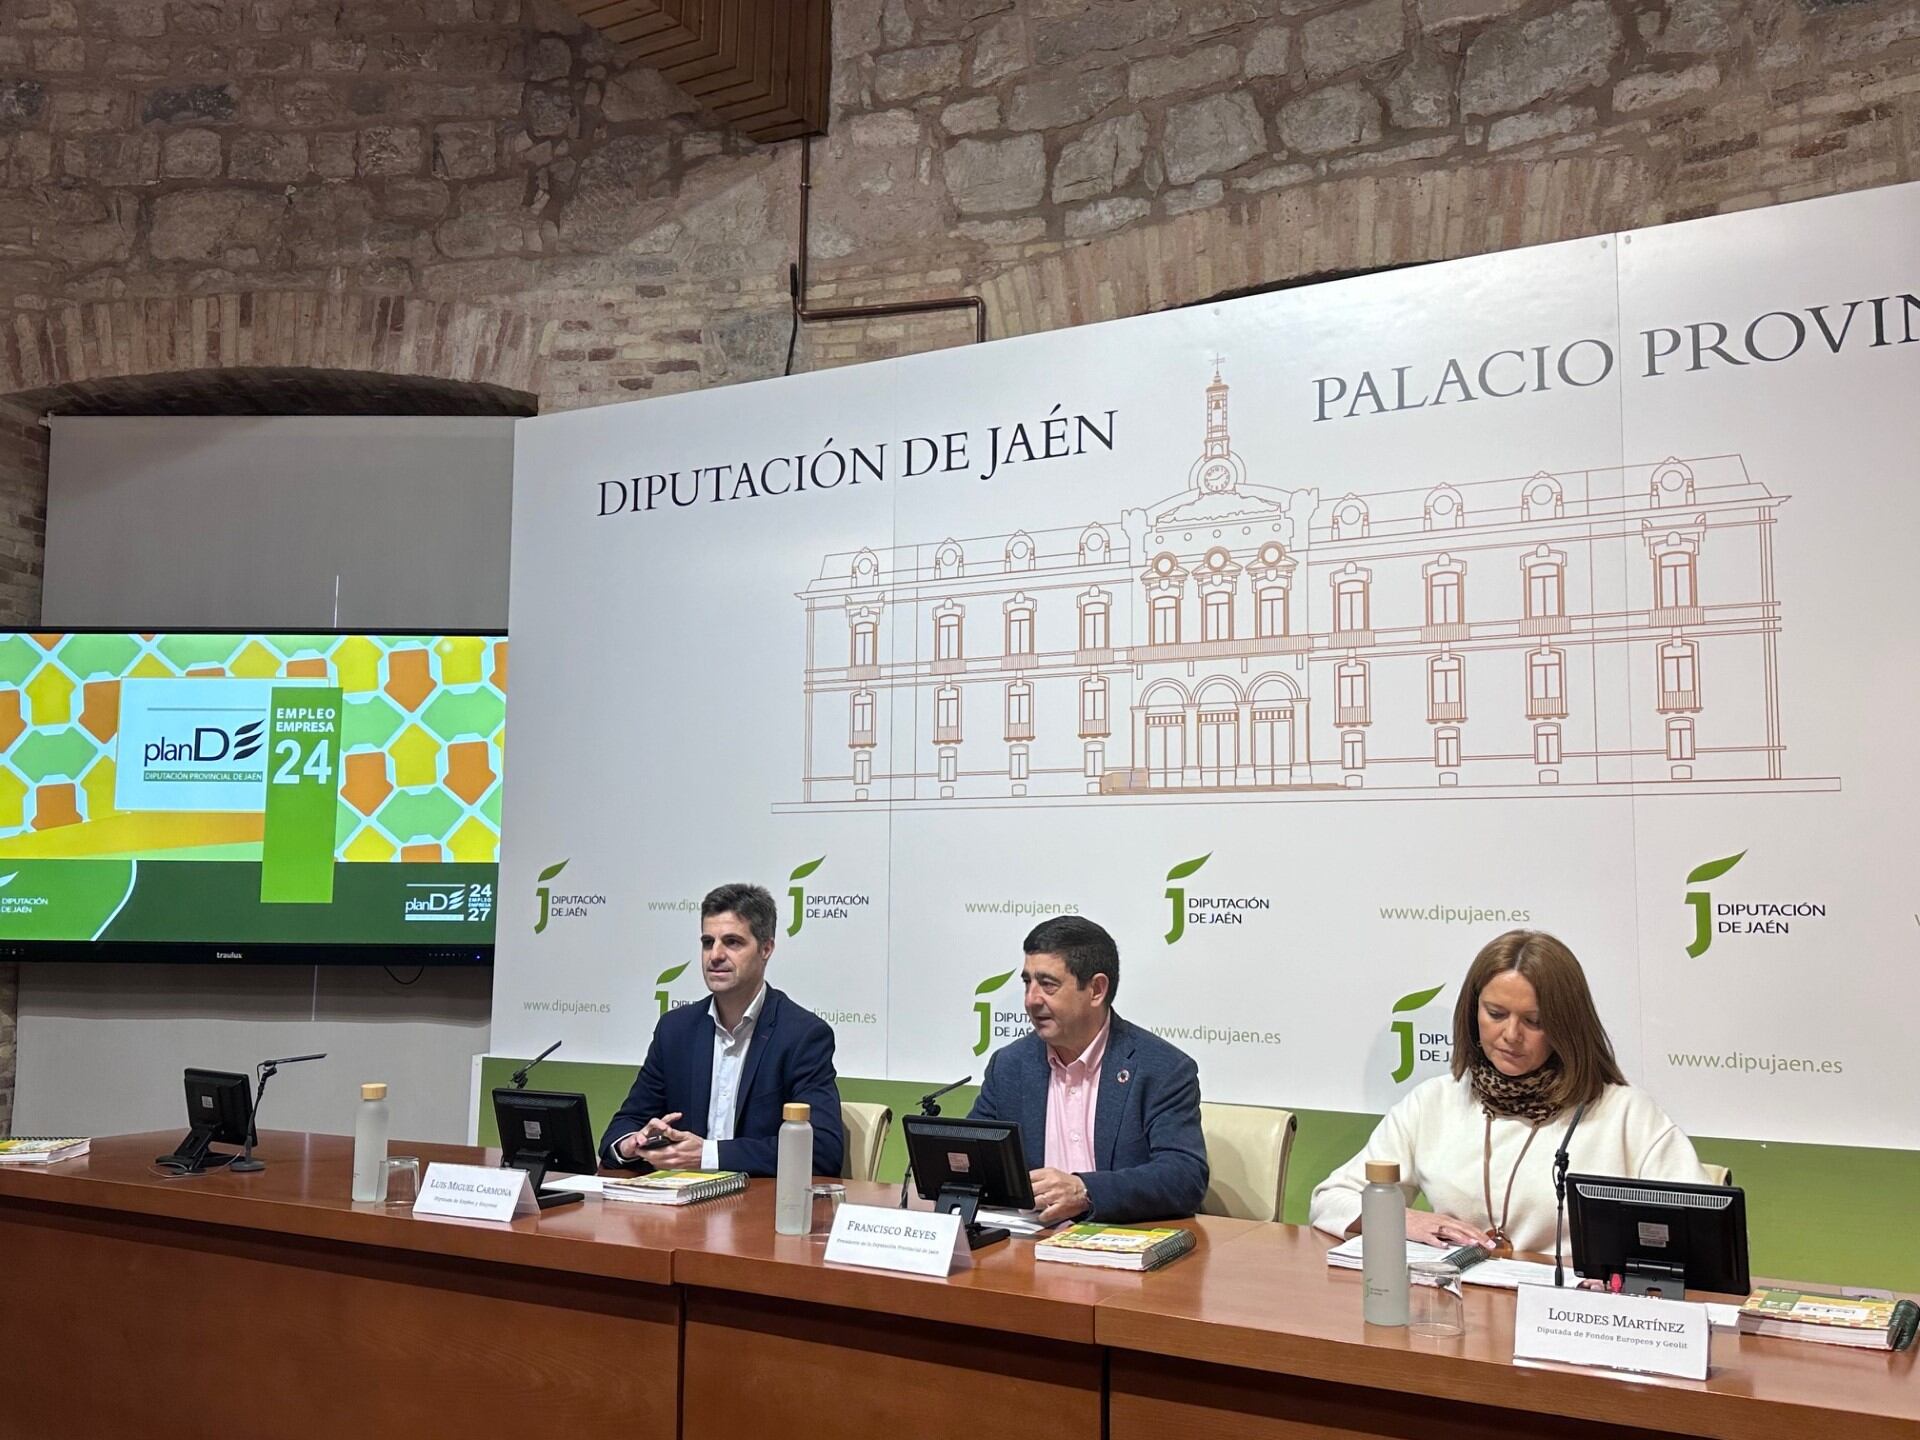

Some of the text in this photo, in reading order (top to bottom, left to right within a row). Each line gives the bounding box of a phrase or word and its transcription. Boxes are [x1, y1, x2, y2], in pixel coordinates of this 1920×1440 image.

[1312, 339, 1615, 422] PALACIO
[597, 404, 1118, 516] DIPUTACIÓN DE JAÉN
[276, 707, 335, 719] EMPLEO
[275, 721, 334, 733] EMPRESA
[272, 739, 332, 784] 24
[145, 772, 188, 780] DIPUTACIÓN
[189, 772, 231, 780] PROVINCIAL
[469, 883, 492, 897] 24
[1, 897, 48, 905] DIPUTACIÓN
[551, 894, 606, 904] DIPUTACIÓN
[806, 893, 869, 905] DIPUTACIÓN
[1188, 897, 1269, 909] DIPUTACIÓN
[467, 908, 491, 921] 27
[551, 906, 587, 916] DE JAÉN
[806, 907, 848, 918] DE JAÉN
[965, 899, 1079, 917] www.dipujaen.es
[1380, 904, 1530, 925] www.dipujaen.es
[1717, 902, 1826, 917] DIPUTACIÓN
[1188, 911, 1242, 924] DE JAÉN
[1718, 920, 1789, 934] DE JAÉN
[523, 999, 611, 1015] www.dipujaen.es
[994, 1026, 1010, 1037] DE
[1420, 1049, 1440, 1062] DE
[1668, 1051, 1843, 1075] www.dipujaen.es
[430, 1179, 512, 1197] LUIS MIGUEL CARMONA
[847, 1220, 937, 1240] FRANCISCO REYES
[1548, 1308, 1685, 1334] LOURDES MARTÍNEZ
[1537, 1326, 1572, 1337] Diputada
[1574, 1330, 1583, 1338] de
[1585, 1331, 1614, 1342] Fondos
[1616, 1335, 1654, 1347] Europeos
